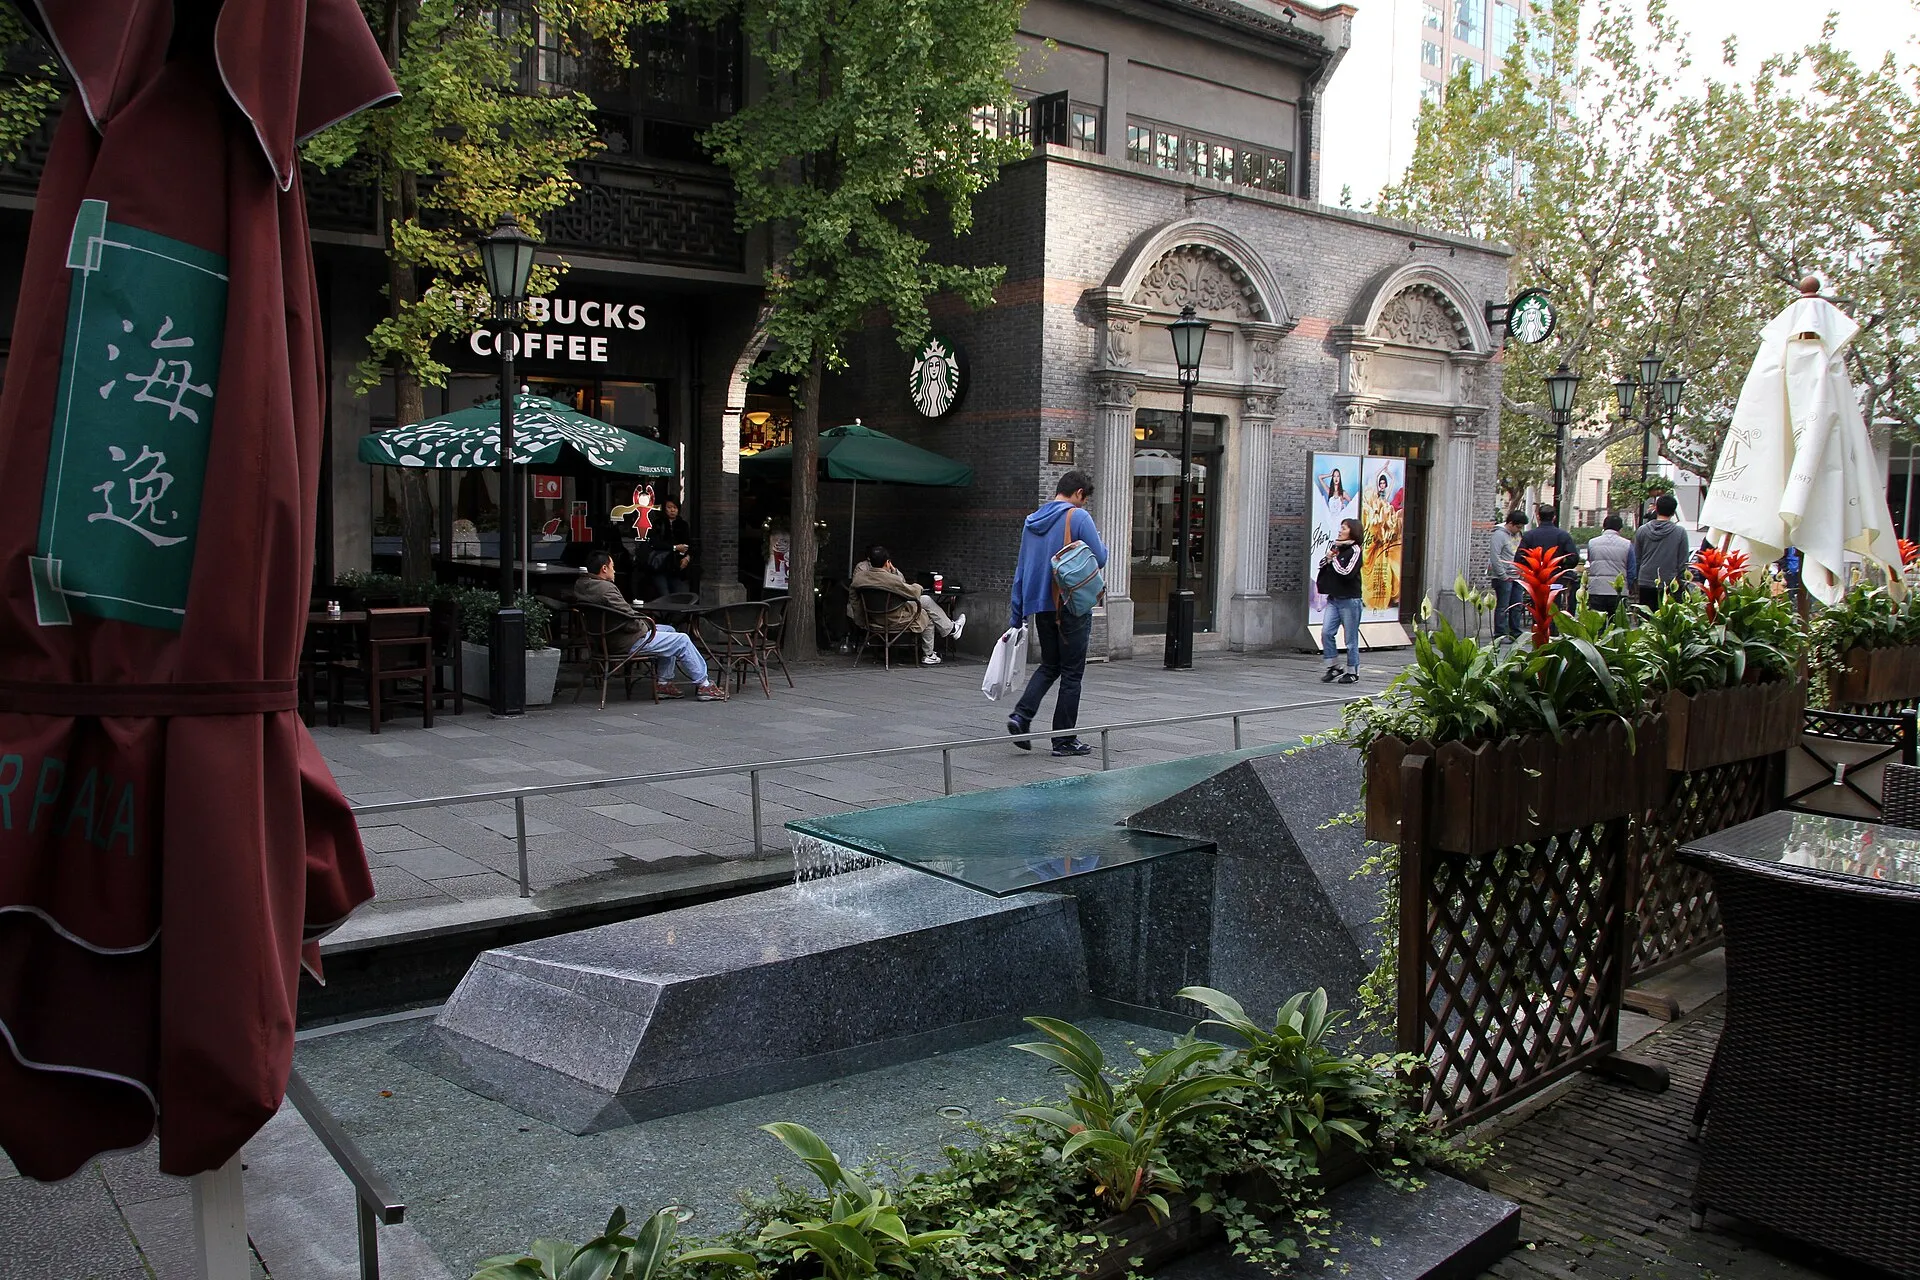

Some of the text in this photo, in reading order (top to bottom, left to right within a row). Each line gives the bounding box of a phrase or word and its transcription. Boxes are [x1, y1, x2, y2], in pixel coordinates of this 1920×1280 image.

[470, 329, 608, 363] COFFEE
[87, 314, 214, 547] 海逸
[1057, 442, 1067, 451] 18
[1740, 493, 1758, 505] 1817
[24, 756, 135, 856] PAZA
